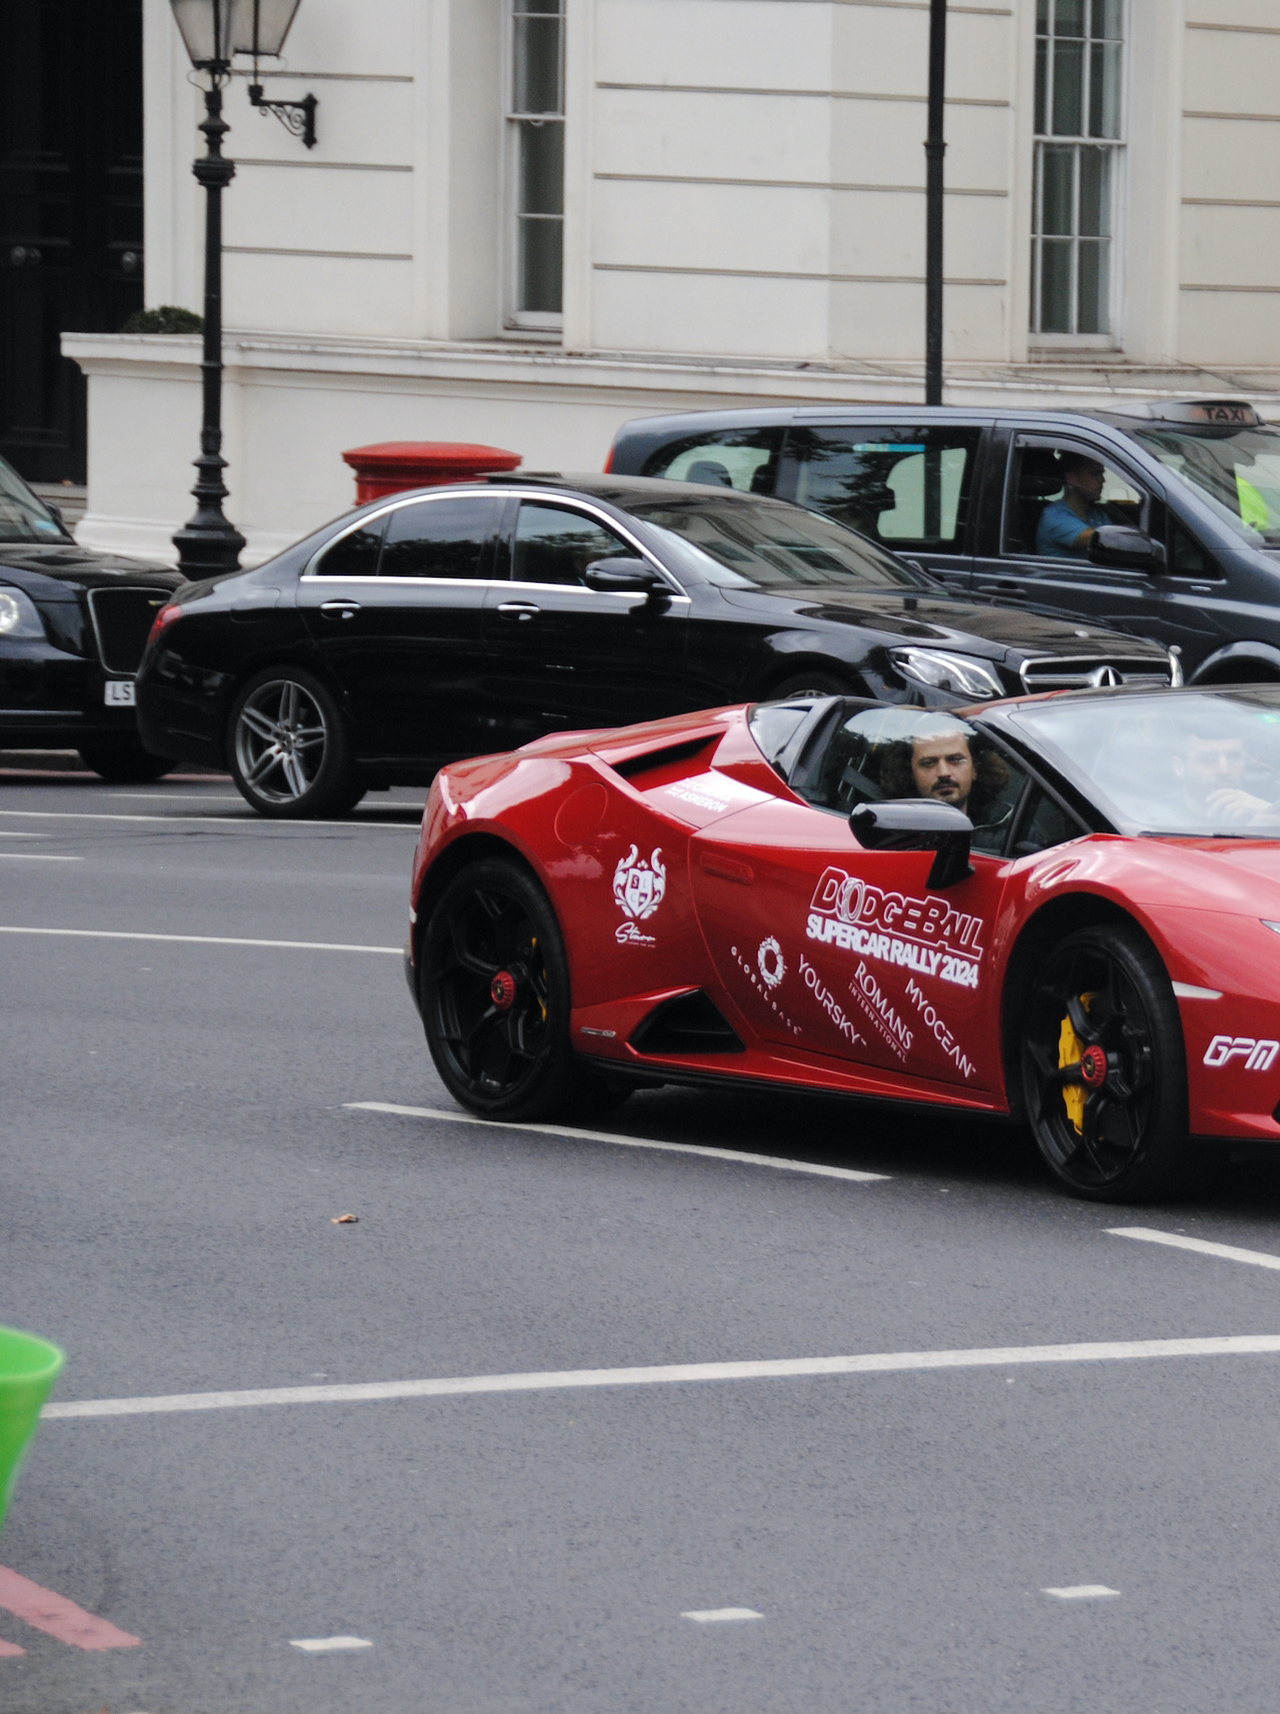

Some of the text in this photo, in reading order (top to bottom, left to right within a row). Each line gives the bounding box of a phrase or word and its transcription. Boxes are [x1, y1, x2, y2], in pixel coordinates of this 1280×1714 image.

[1202, 406, 1245, 422] TAXI
[939, 954, 979, 989] 2024
[848, 982, 907, 1064] INTERNATIONAL
[854, 960, 914, 1050] ROMANS
